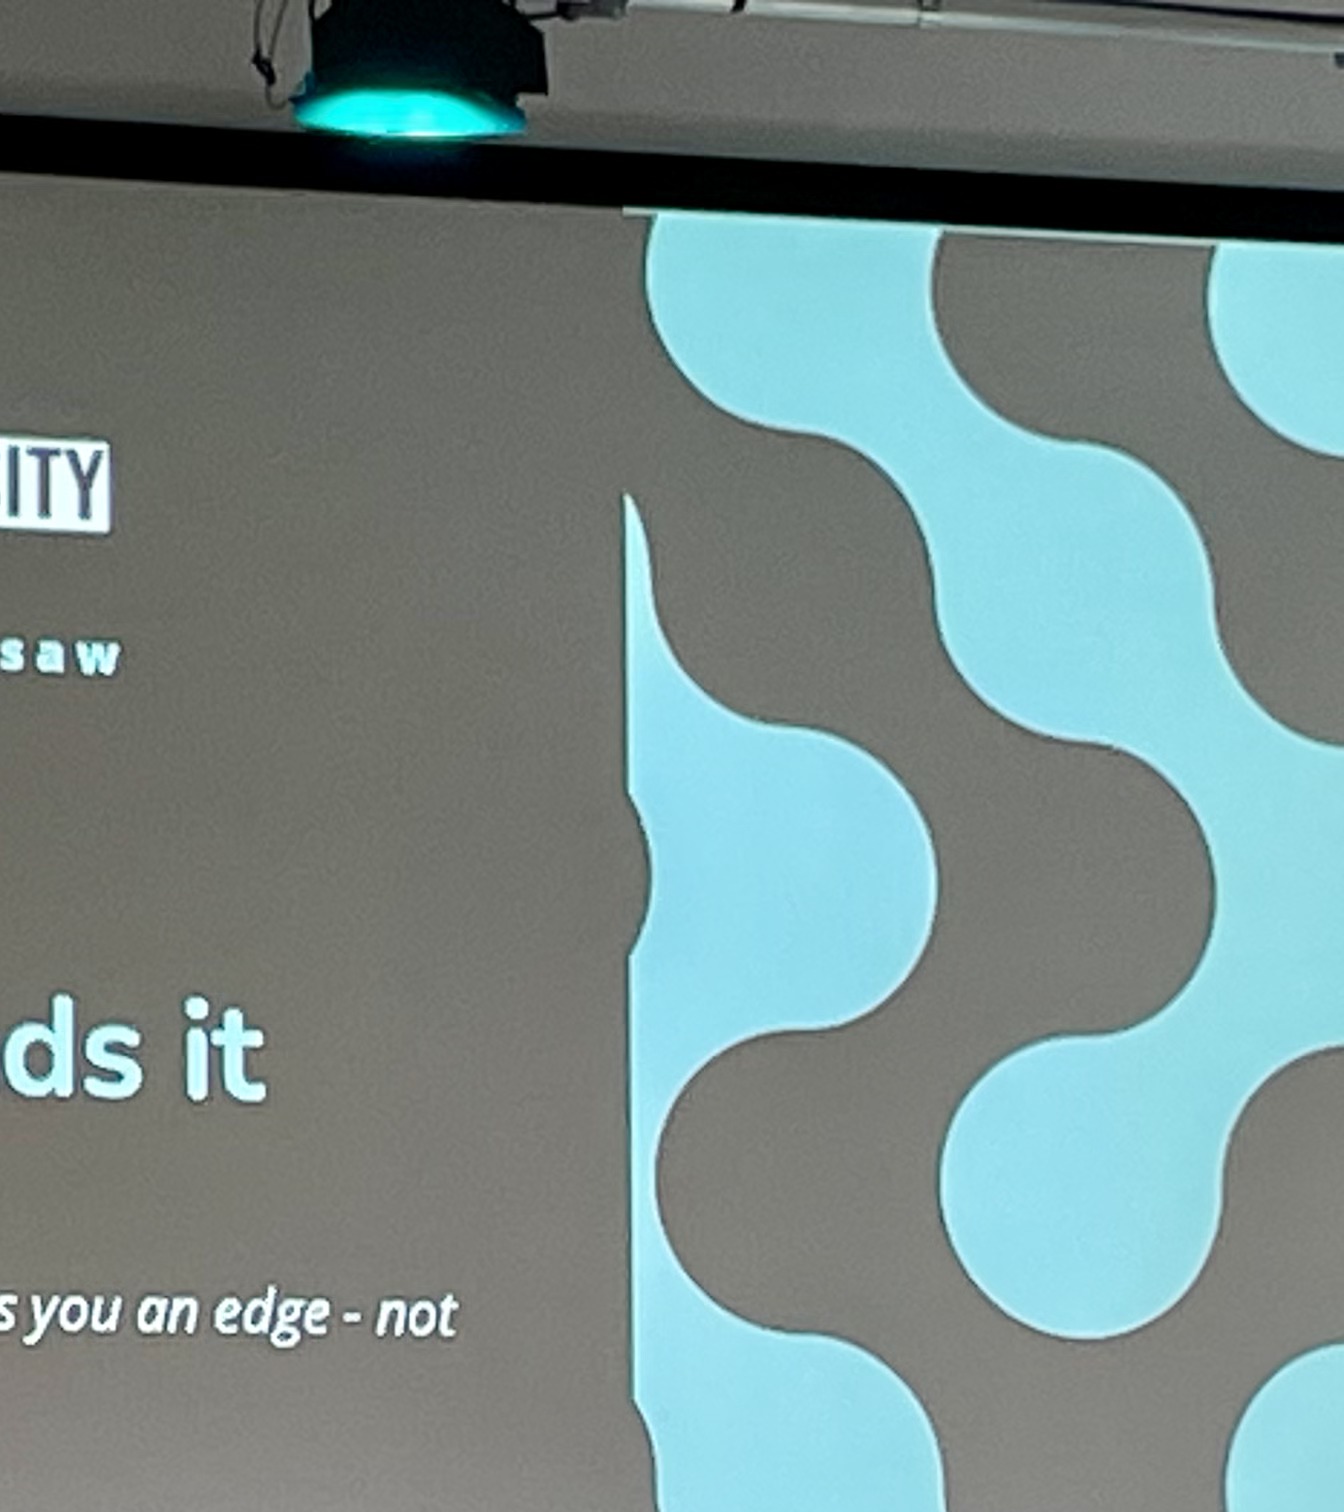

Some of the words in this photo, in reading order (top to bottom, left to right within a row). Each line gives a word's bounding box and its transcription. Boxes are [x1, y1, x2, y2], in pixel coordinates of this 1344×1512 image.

[184, 996, 268, 1103] it
[21, 1293, 124, 1347] you
[136, 1295, 200, 1335] an
[213, 1284, 331, 1349] edge
[374, 1293, 461, 1338] not
